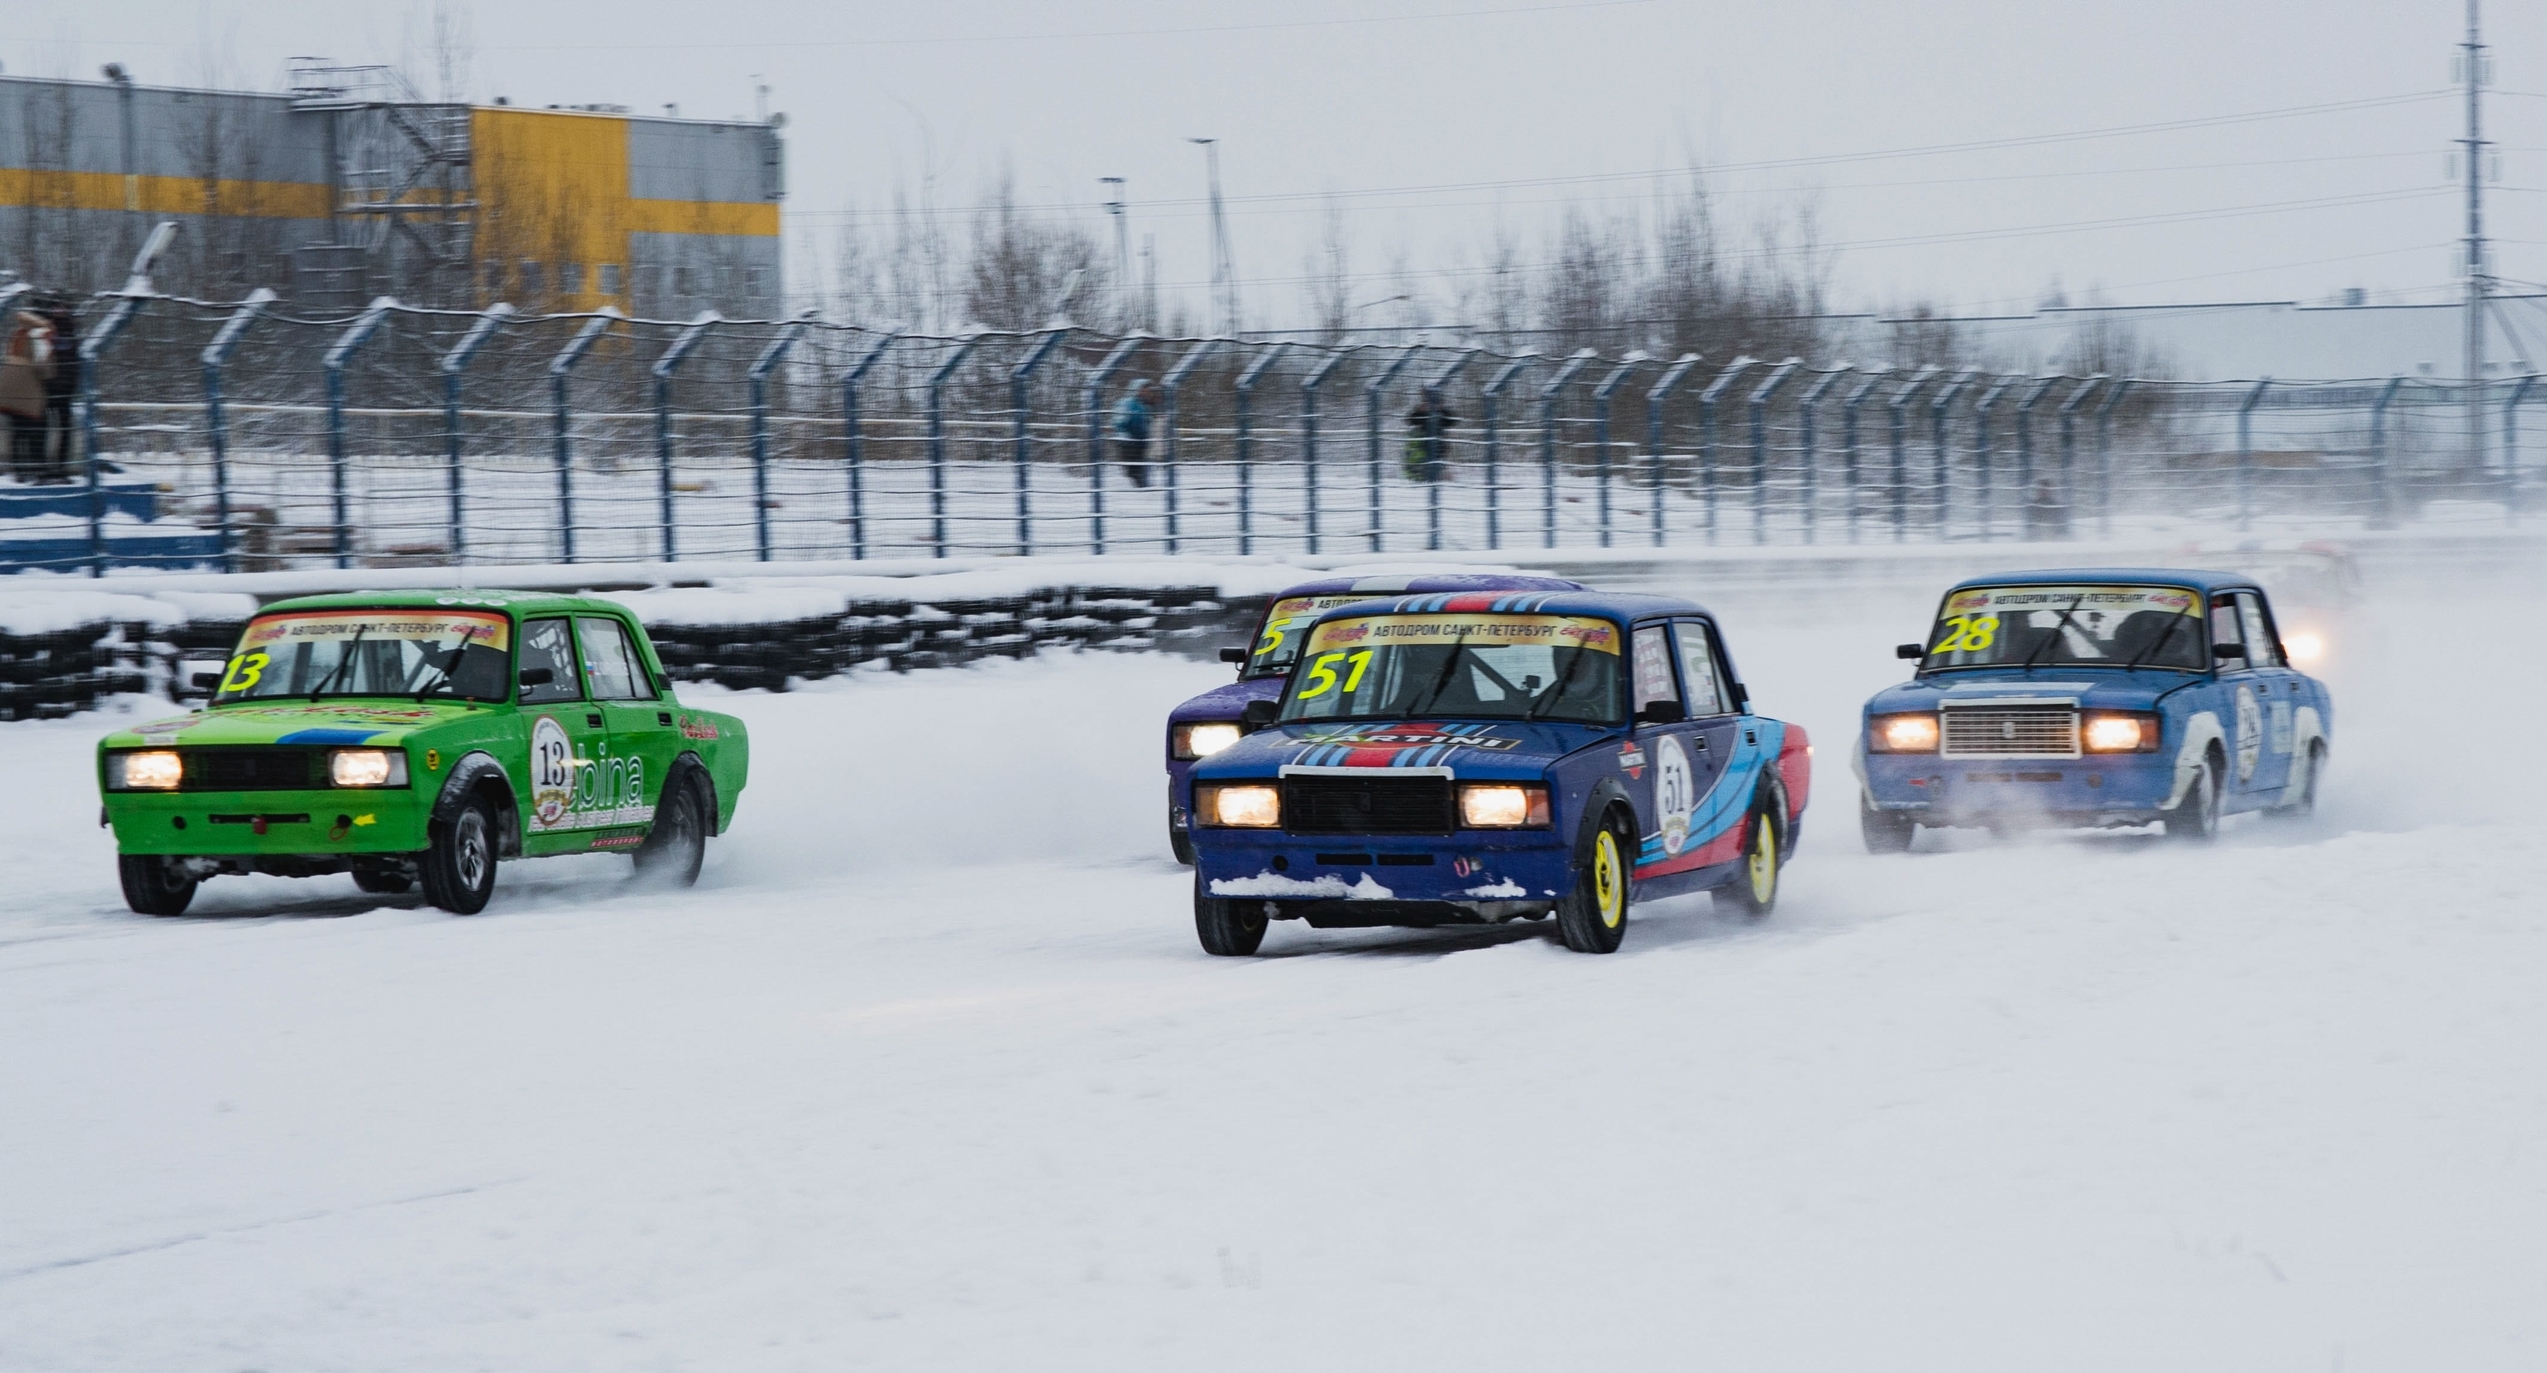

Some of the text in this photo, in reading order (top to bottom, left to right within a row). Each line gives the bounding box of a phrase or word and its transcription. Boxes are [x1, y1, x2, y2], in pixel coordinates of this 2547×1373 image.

[1253, 617, 1293, 656] 5
[1373, 625, 1440, 637] АВТОДРОМ
[1443, 624, 1558, 637] САНКТ-ПЕТЕРБУРГ
[1931, 616, 2000, 655] 28
[217, 652, 271, 693] 13
[1297, 650, 1375, 700] 51
[1285, 733, 1505, 748] MARTINI
[539, 741, 566, 787] 13
[1664, 764, 1685, 815] 51
